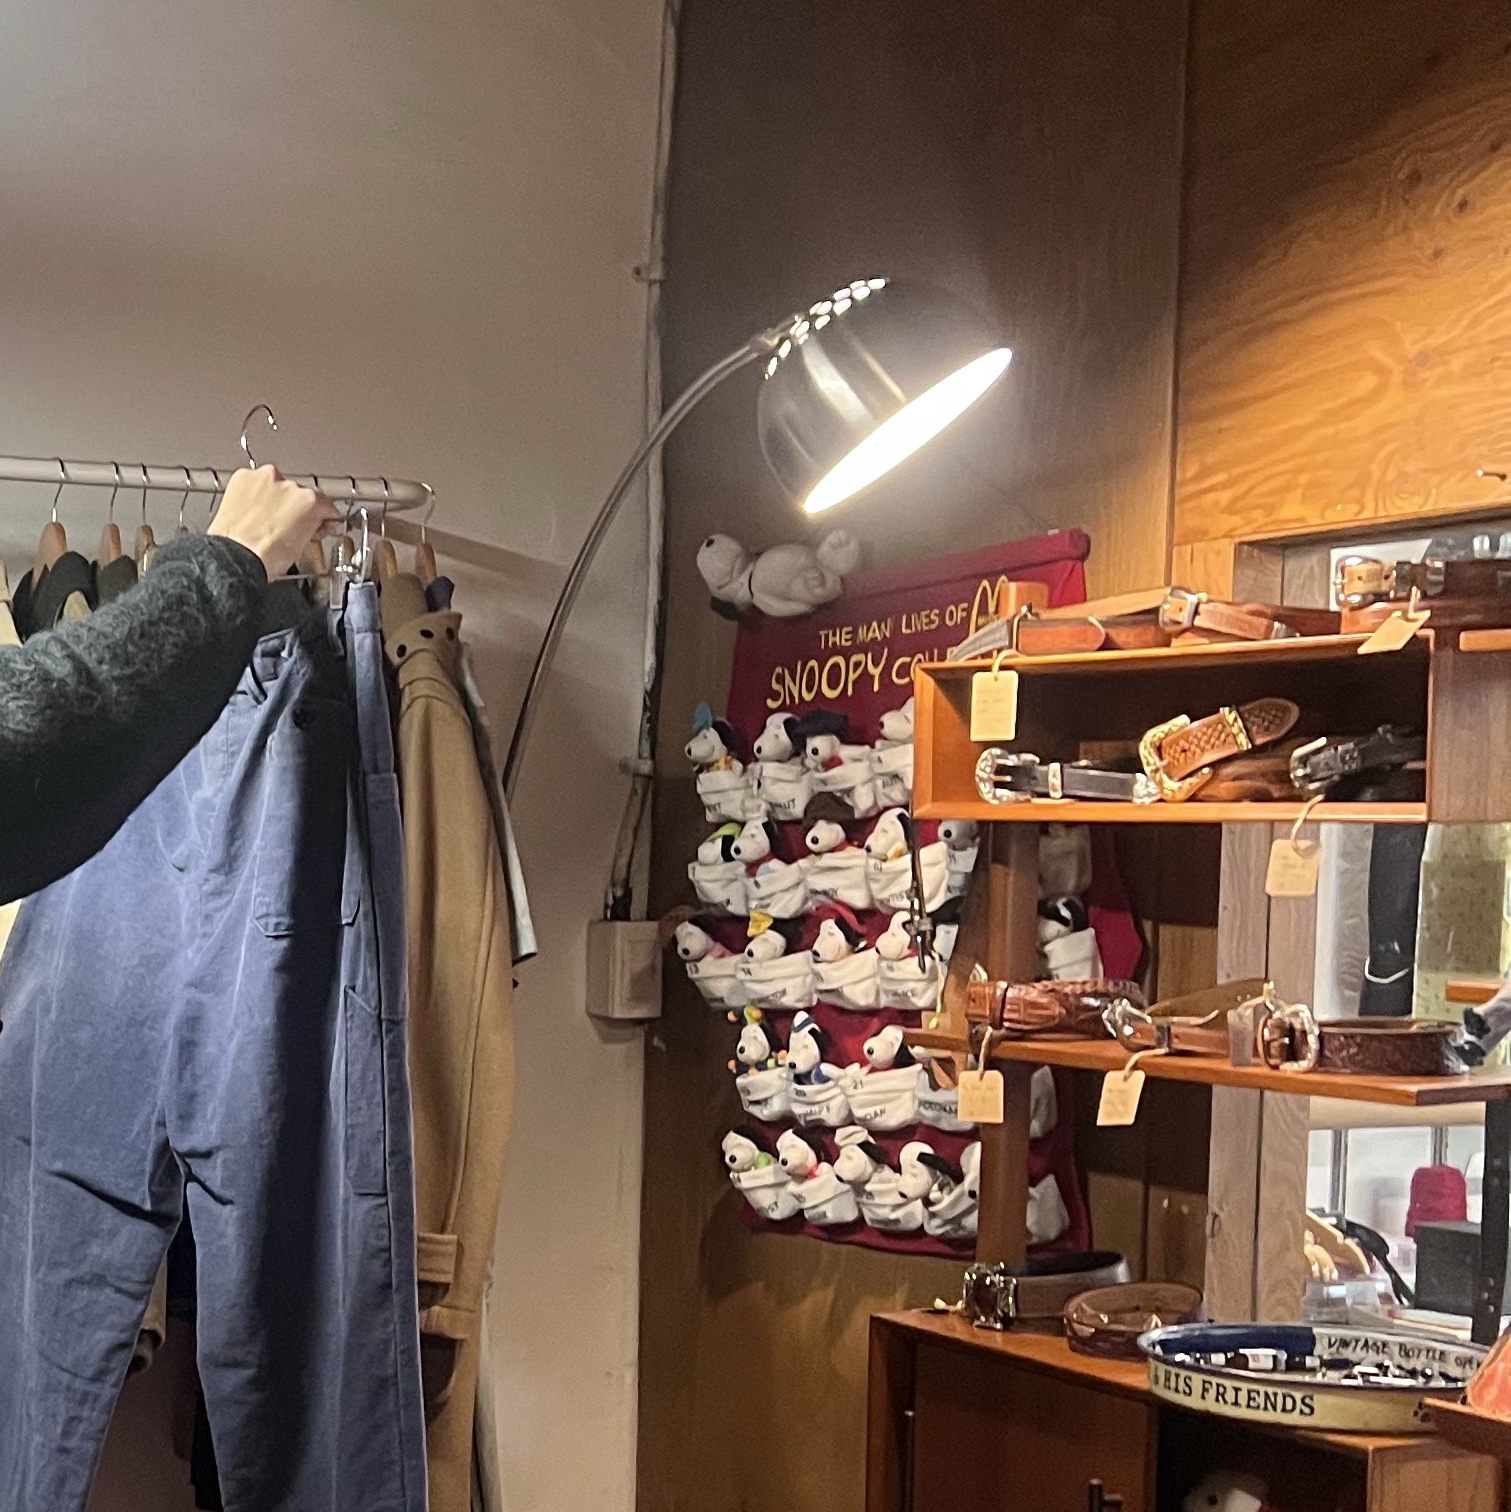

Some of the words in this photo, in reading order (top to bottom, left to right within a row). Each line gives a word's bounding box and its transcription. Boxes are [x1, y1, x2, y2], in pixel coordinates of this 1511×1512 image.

[819, 626, 853, 649] THE
[901, 608, 940, 635] LIVES
[945, 603, 969, 627] OF
[766, 647, 888, 709] SNOOPY
[1327, 1336, 1390, 1356] VINTAGE
[1398, 1343, 1448, 1362] BOTTLE
[1164, 1368, 1193, 1397] HIS
[1201, 1378, 1315, 1416] FRIENDS
